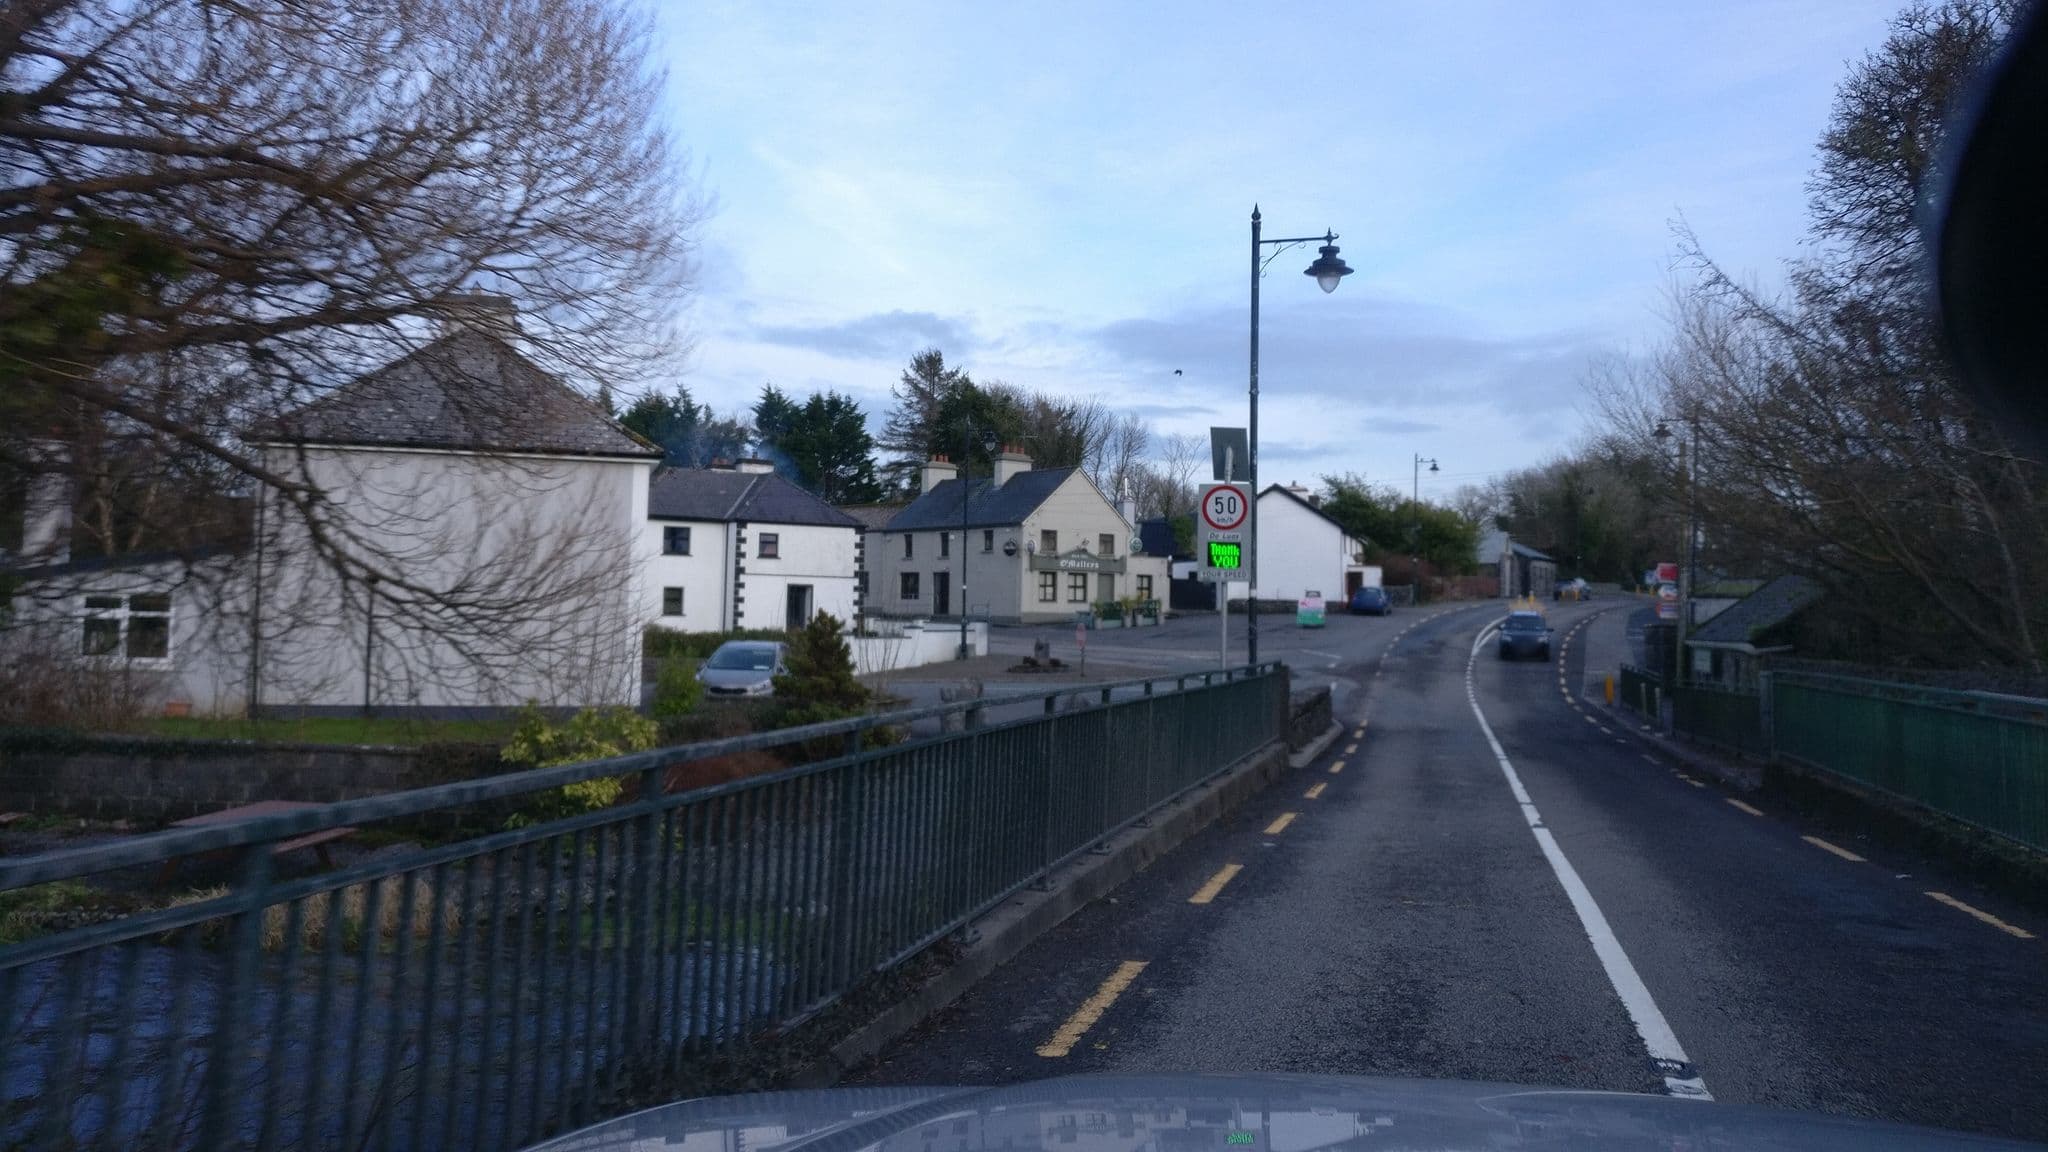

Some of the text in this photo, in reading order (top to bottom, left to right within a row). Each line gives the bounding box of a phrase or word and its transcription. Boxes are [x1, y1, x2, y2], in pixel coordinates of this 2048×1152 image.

[1215, 496, 1236, 514] 50
[1213, 555, 1239, 569] YOU
[1224, 571, 1247, 579] SPEED
